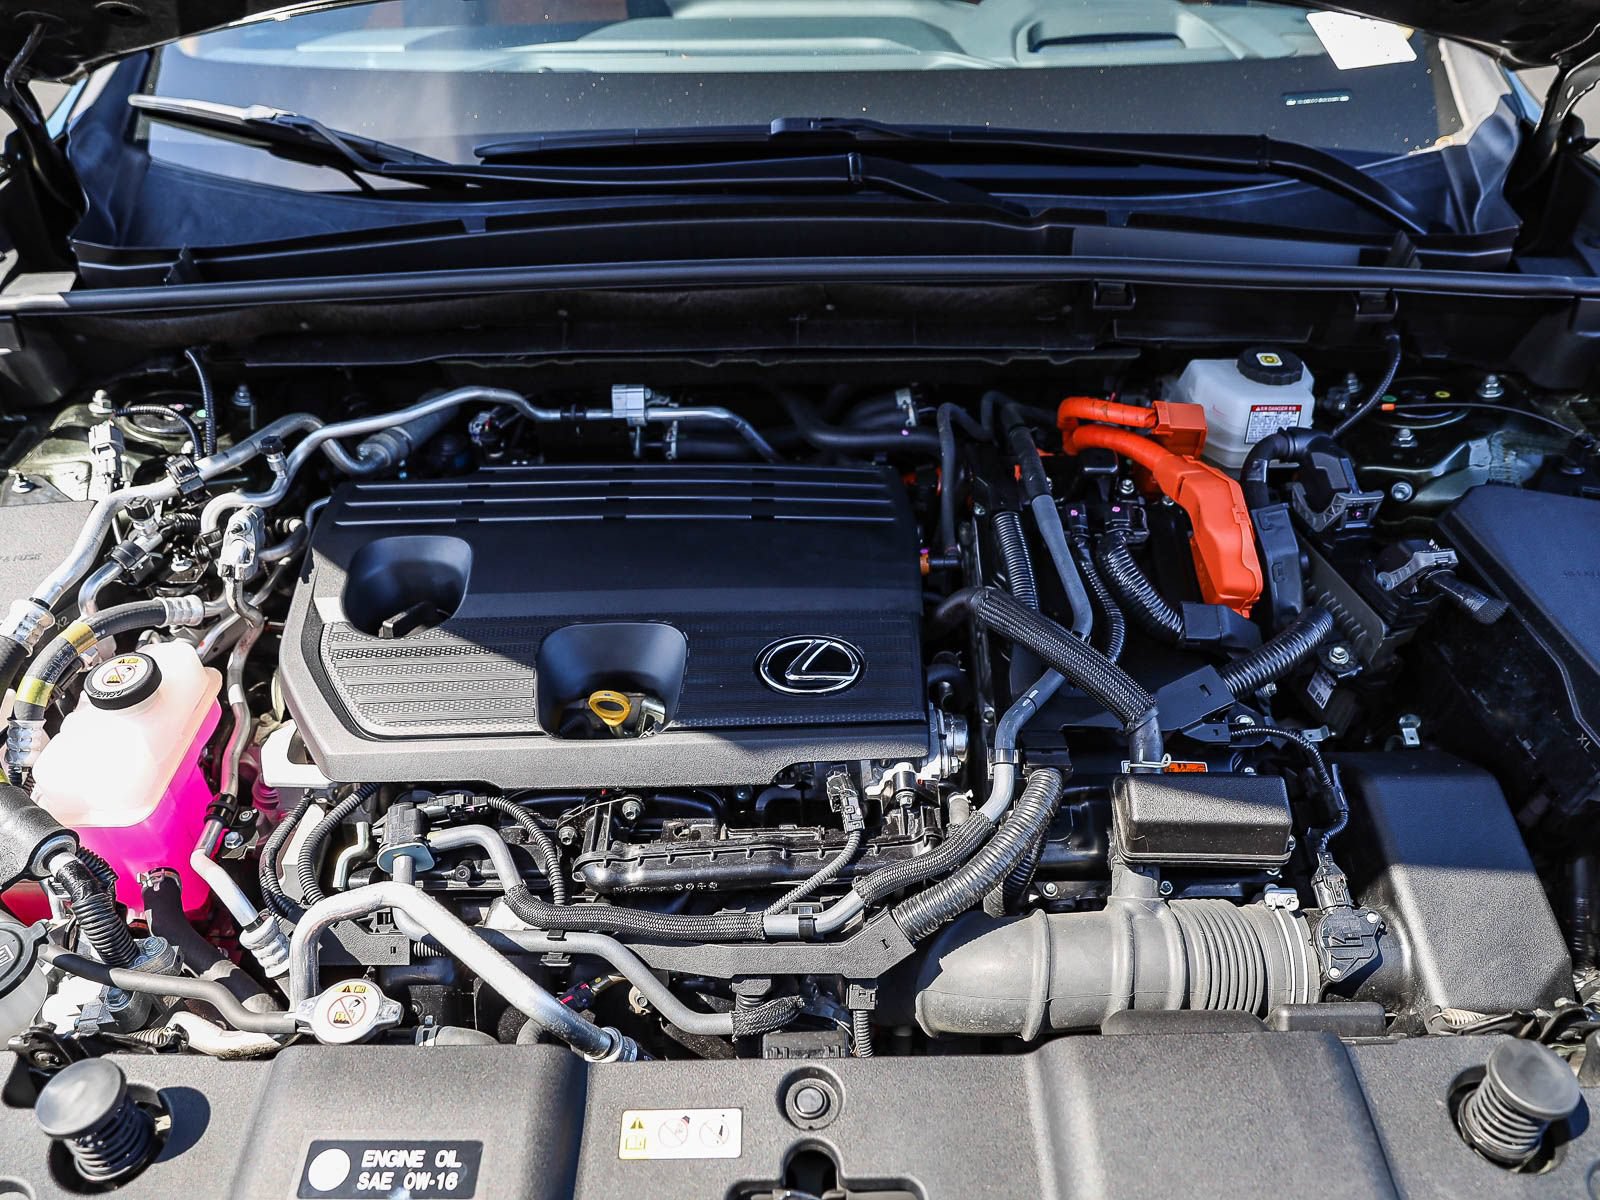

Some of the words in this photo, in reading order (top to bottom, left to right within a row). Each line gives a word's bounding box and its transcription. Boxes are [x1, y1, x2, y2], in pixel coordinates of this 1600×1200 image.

[361, 1149, 426, 1168] ENGINE
[434, 1149, 462, 1168] OIL
[356, 1171, 394, 1191] SAE
